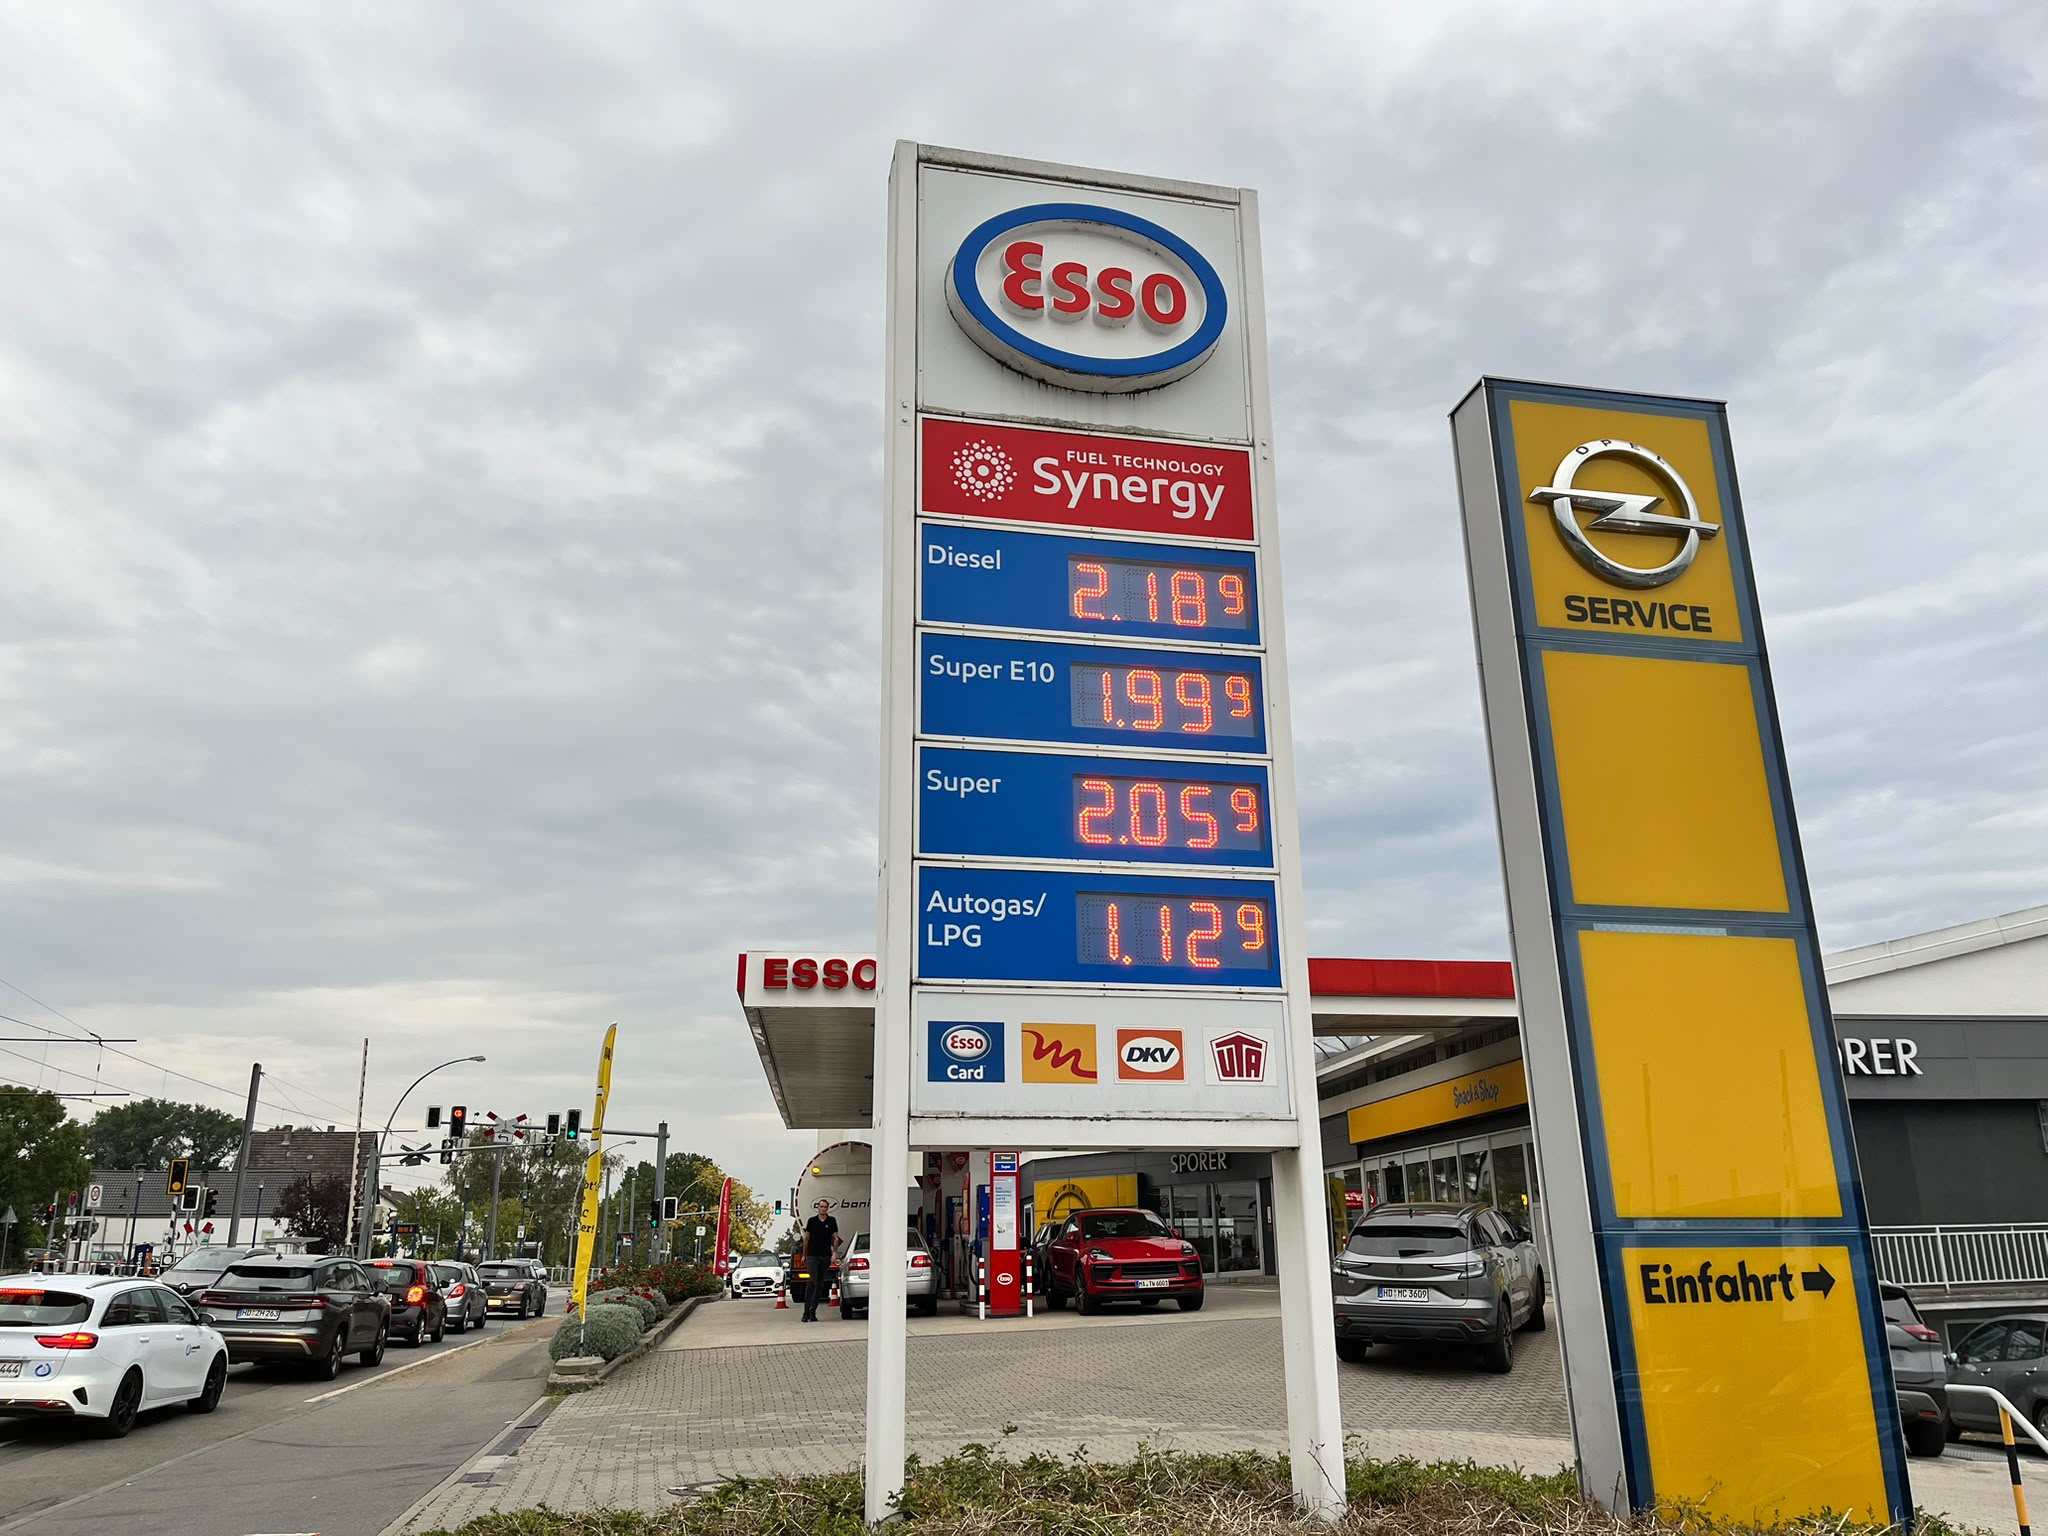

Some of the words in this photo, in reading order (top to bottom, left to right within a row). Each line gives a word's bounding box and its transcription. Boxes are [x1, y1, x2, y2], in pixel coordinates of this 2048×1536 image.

[1066, 450, 1108, 466] FUEL
[1112, 454, 1224, 477] TECHNOLOGY
[1576, 438, 1665, 465] OPEL
[1033, 456, 1226, 522] Synergy
[928, 544, 1002, 570] Diesel
[1564, 595, 1713, 633] SERVICE
[929, 655, 1003, 682] Super
[1010, 660, 1055, 683] E10
[927, 770, 1001, 796] Super
[926, 890, 1046, 921] Autogas/
[927, 924, 982, 947] LPG
[763, 958, 877, 990] ESSO
[950, 1035, 984, 1050] Esso
[1126, 1047, 1175, 1063] DKV
[1215, 1034, 1263, 1078] UTA
[1838, 1038, 1924, 1075] RER
[947, 1065, 984, 1080] Card
[1170, 1152, 1227, 1173] SPORER
[1408, 1289, 1427, 1298] 3609
[1640, 1260, 1794, 1303] Einfahrt
